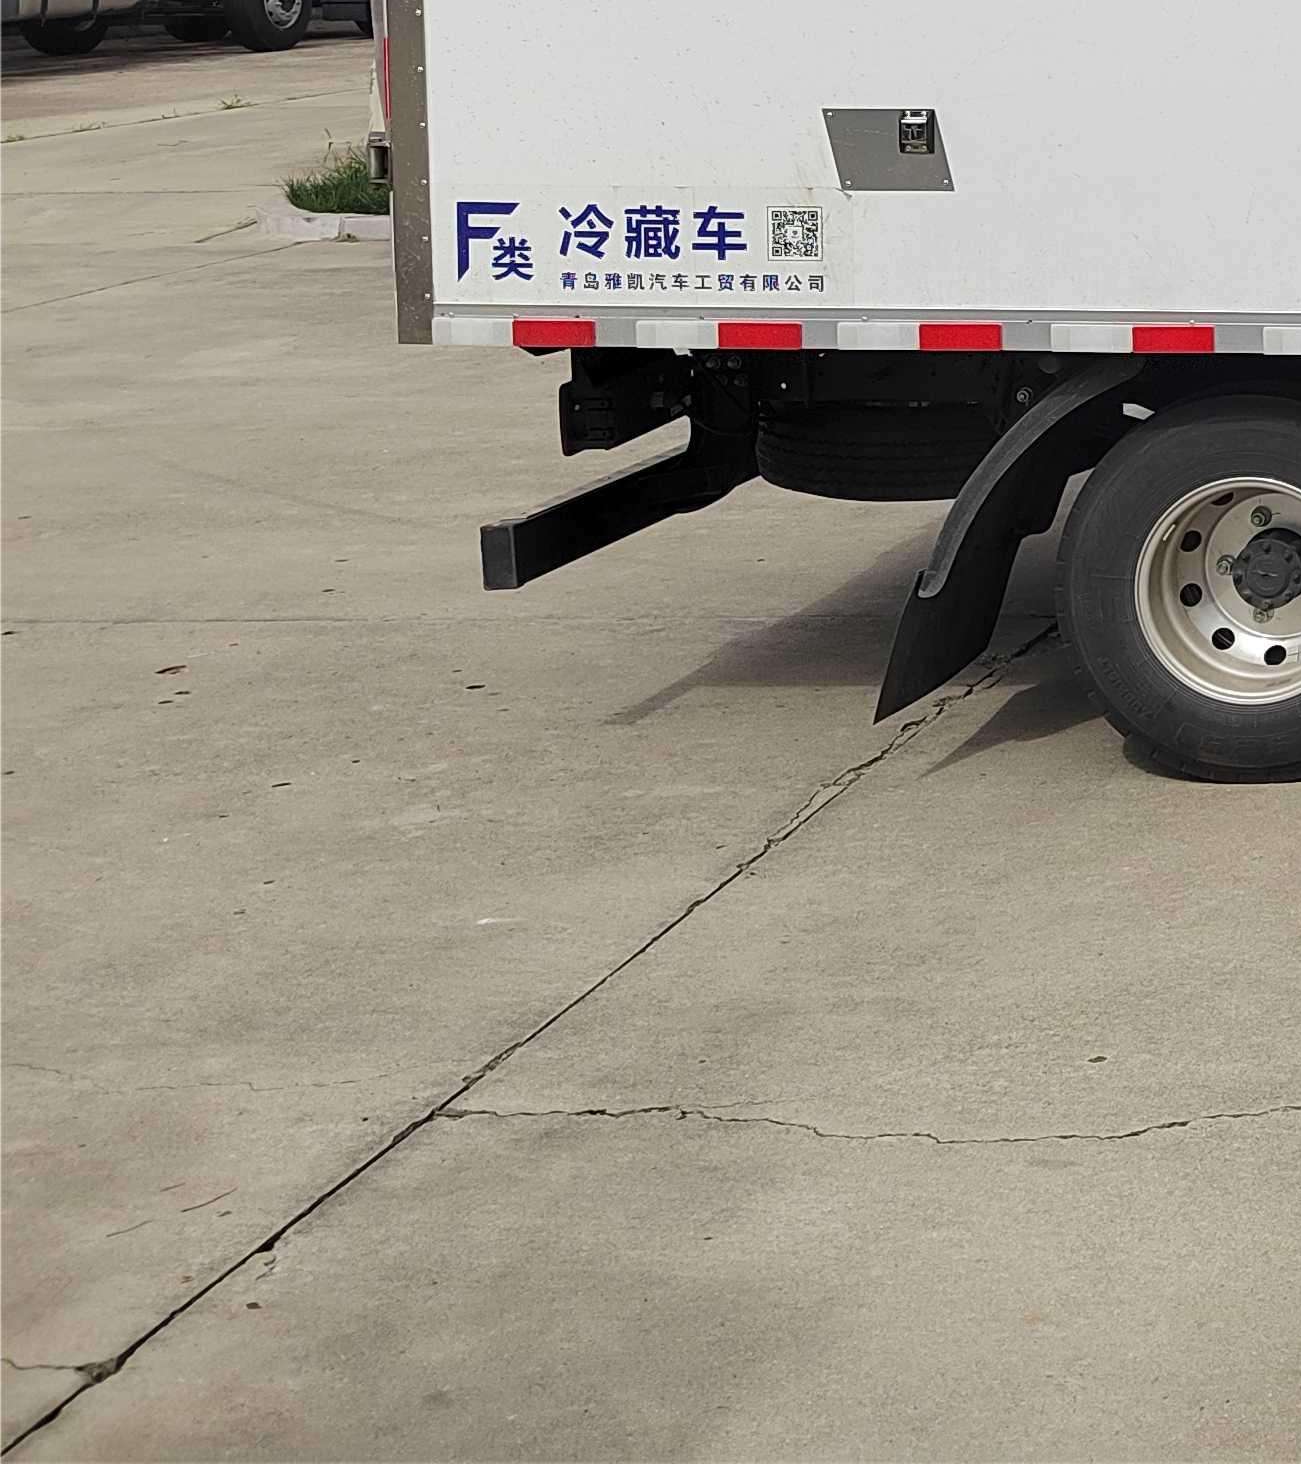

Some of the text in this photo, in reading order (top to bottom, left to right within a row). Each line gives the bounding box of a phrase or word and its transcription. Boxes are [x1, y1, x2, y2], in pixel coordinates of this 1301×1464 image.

[558, 203, 748, 260] 冷藏车
[559, 272, 826, 293] 青岛雅凯汽车工贸有限公司
